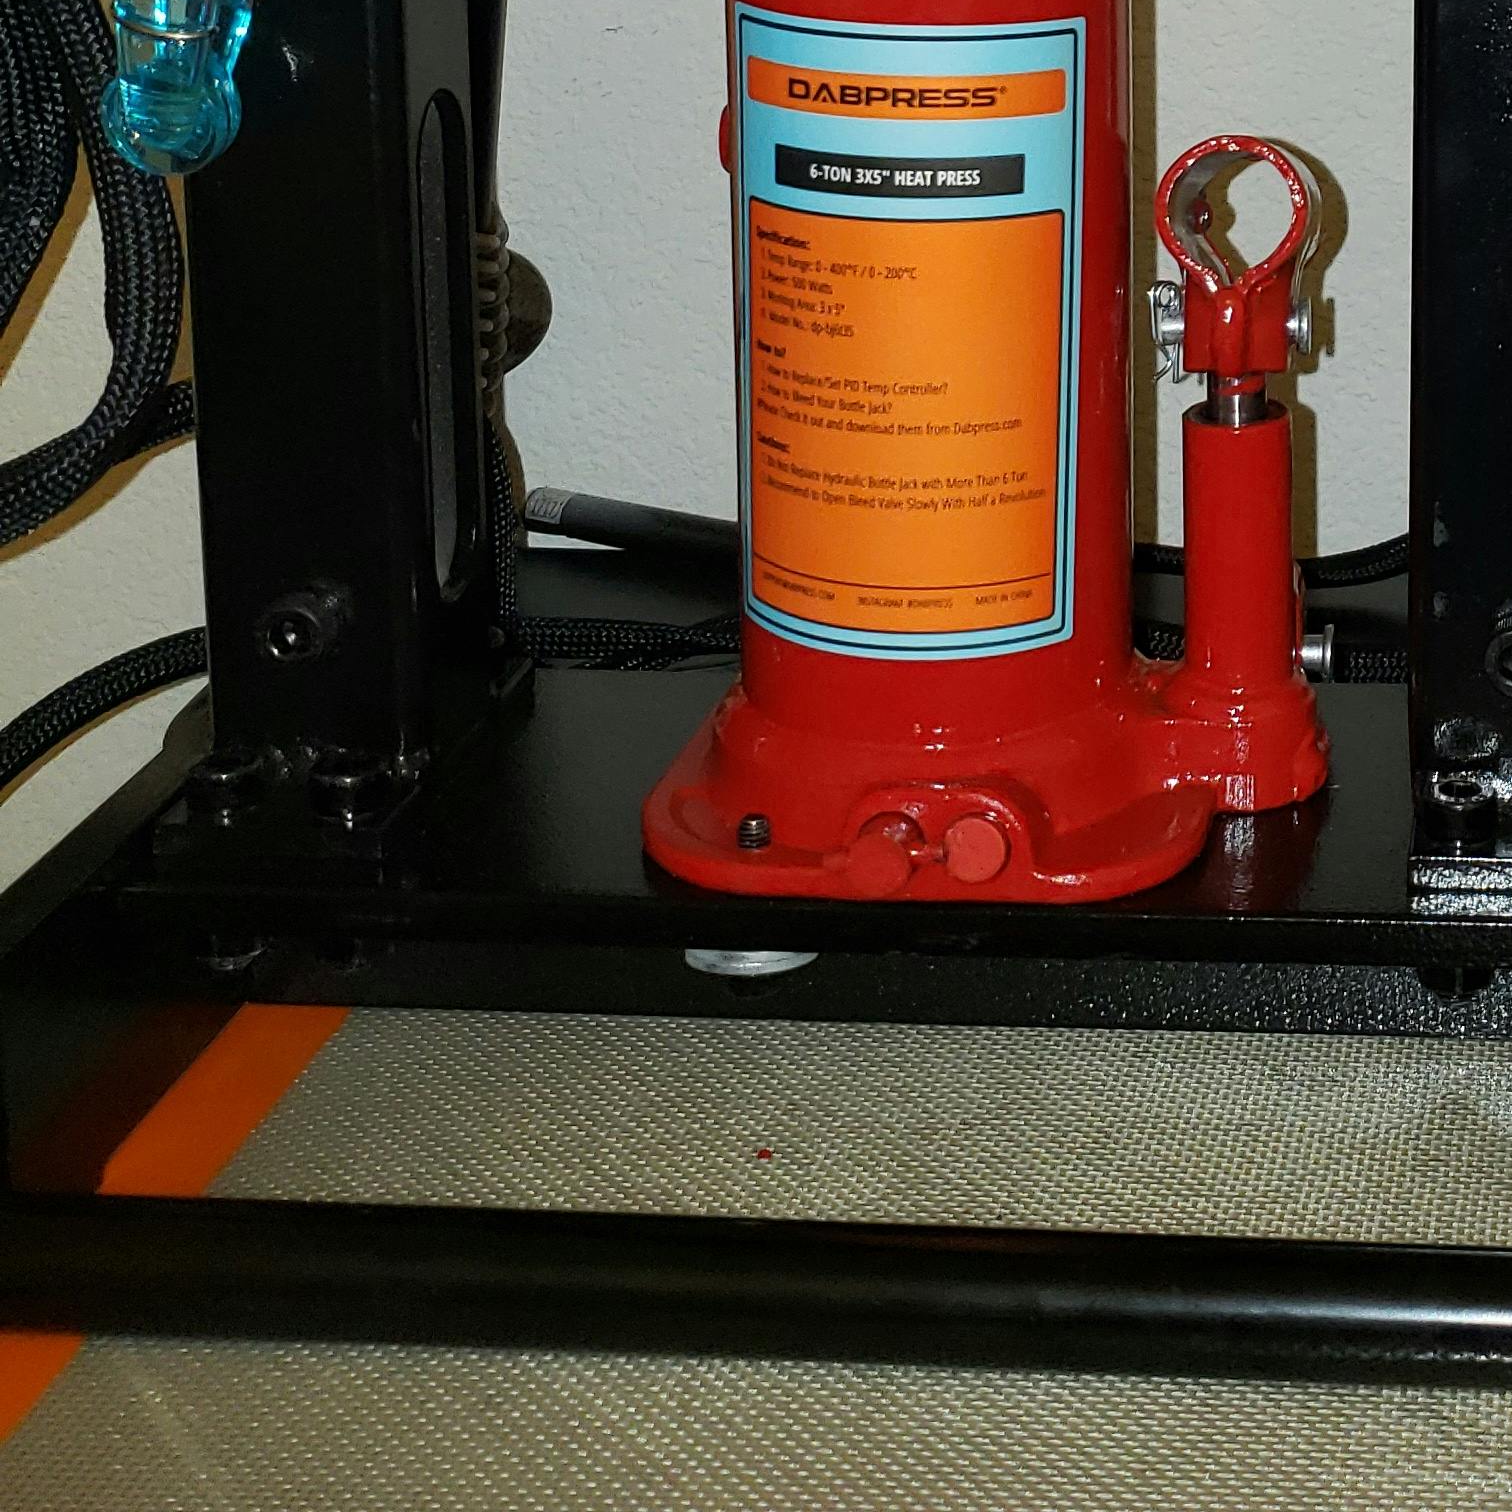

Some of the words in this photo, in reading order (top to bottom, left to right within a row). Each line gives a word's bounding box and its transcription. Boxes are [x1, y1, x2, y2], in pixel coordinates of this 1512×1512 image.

[809, 164, 851, 183] 6-TON
[895, 171, 934, 187] HEAT
[937, 170, 981, 186] PRESS
[861, 380, 889, 396] Temp
[926, 422, 951, 435] from
